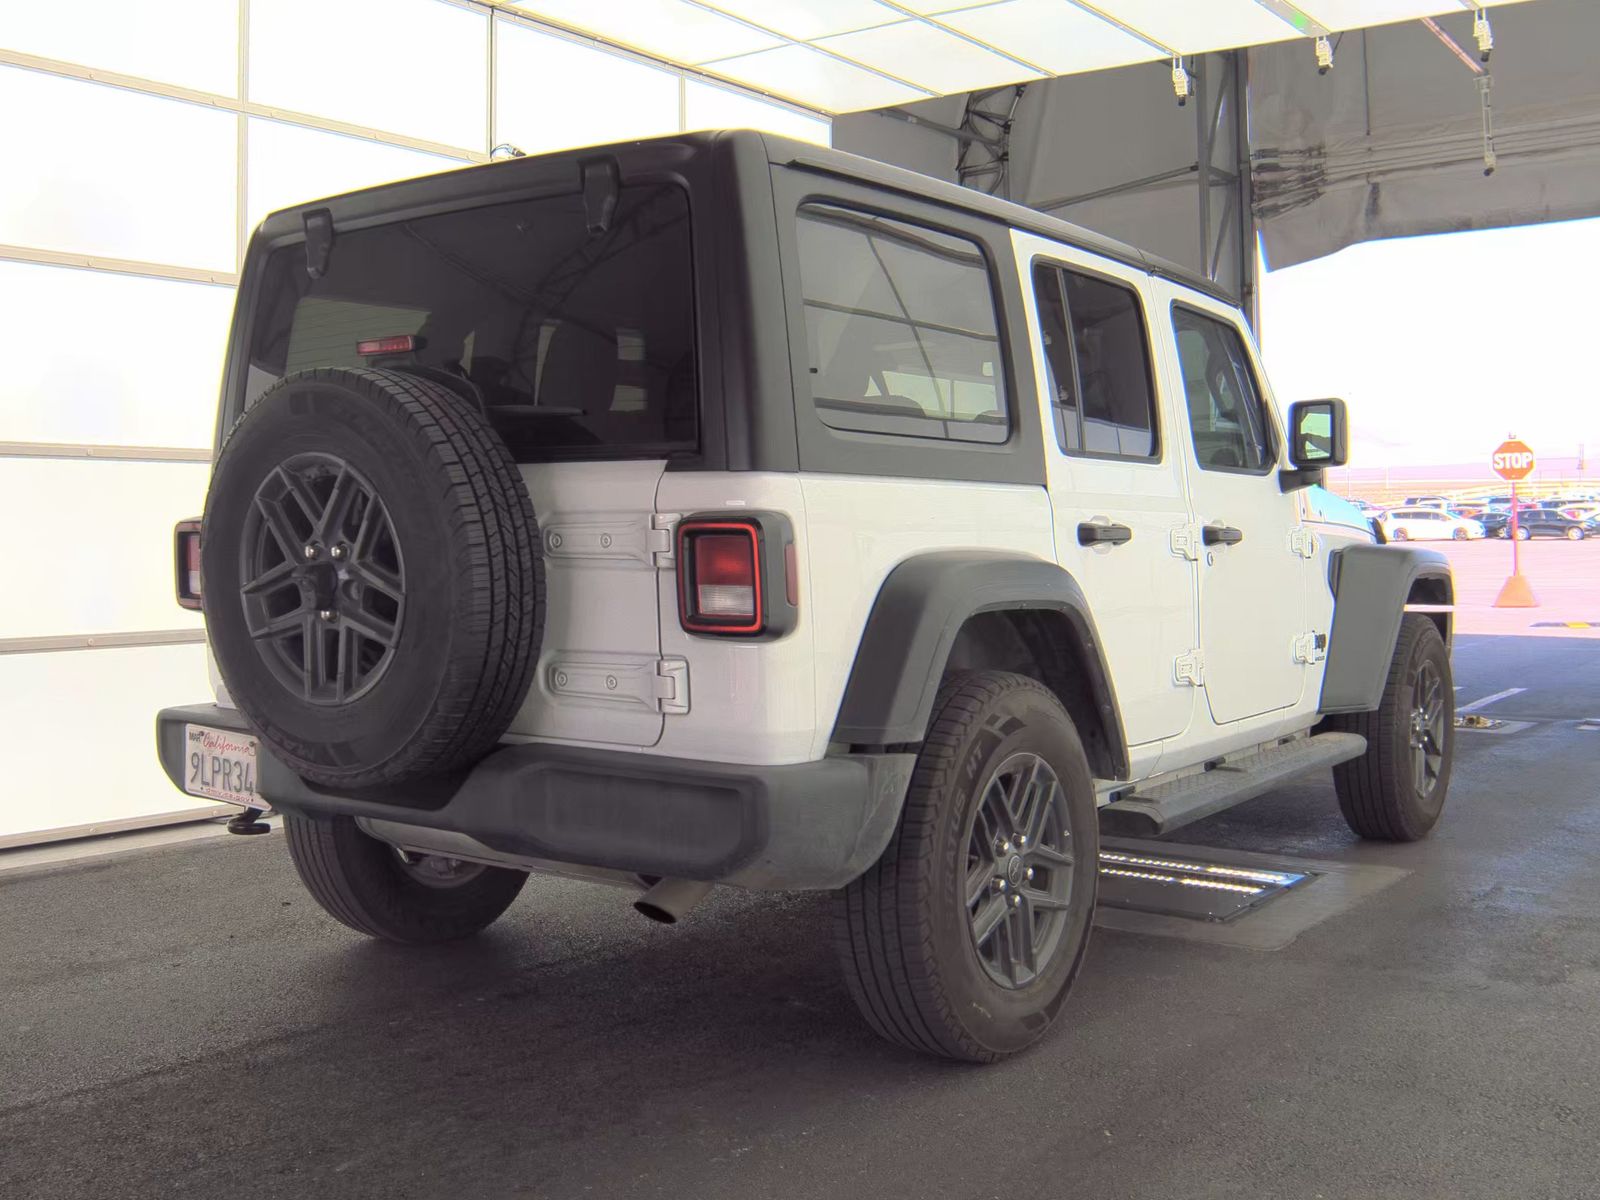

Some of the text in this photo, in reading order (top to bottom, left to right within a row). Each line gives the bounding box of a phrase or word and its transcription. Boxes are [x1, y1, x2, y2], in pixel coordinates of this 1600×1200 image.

[1493, 452, 1533, 469] STOP
[202, 732, 250, 755] California
[190, 752, 253, 796] 9LPR34
[966, 742, 984, 779] HT
